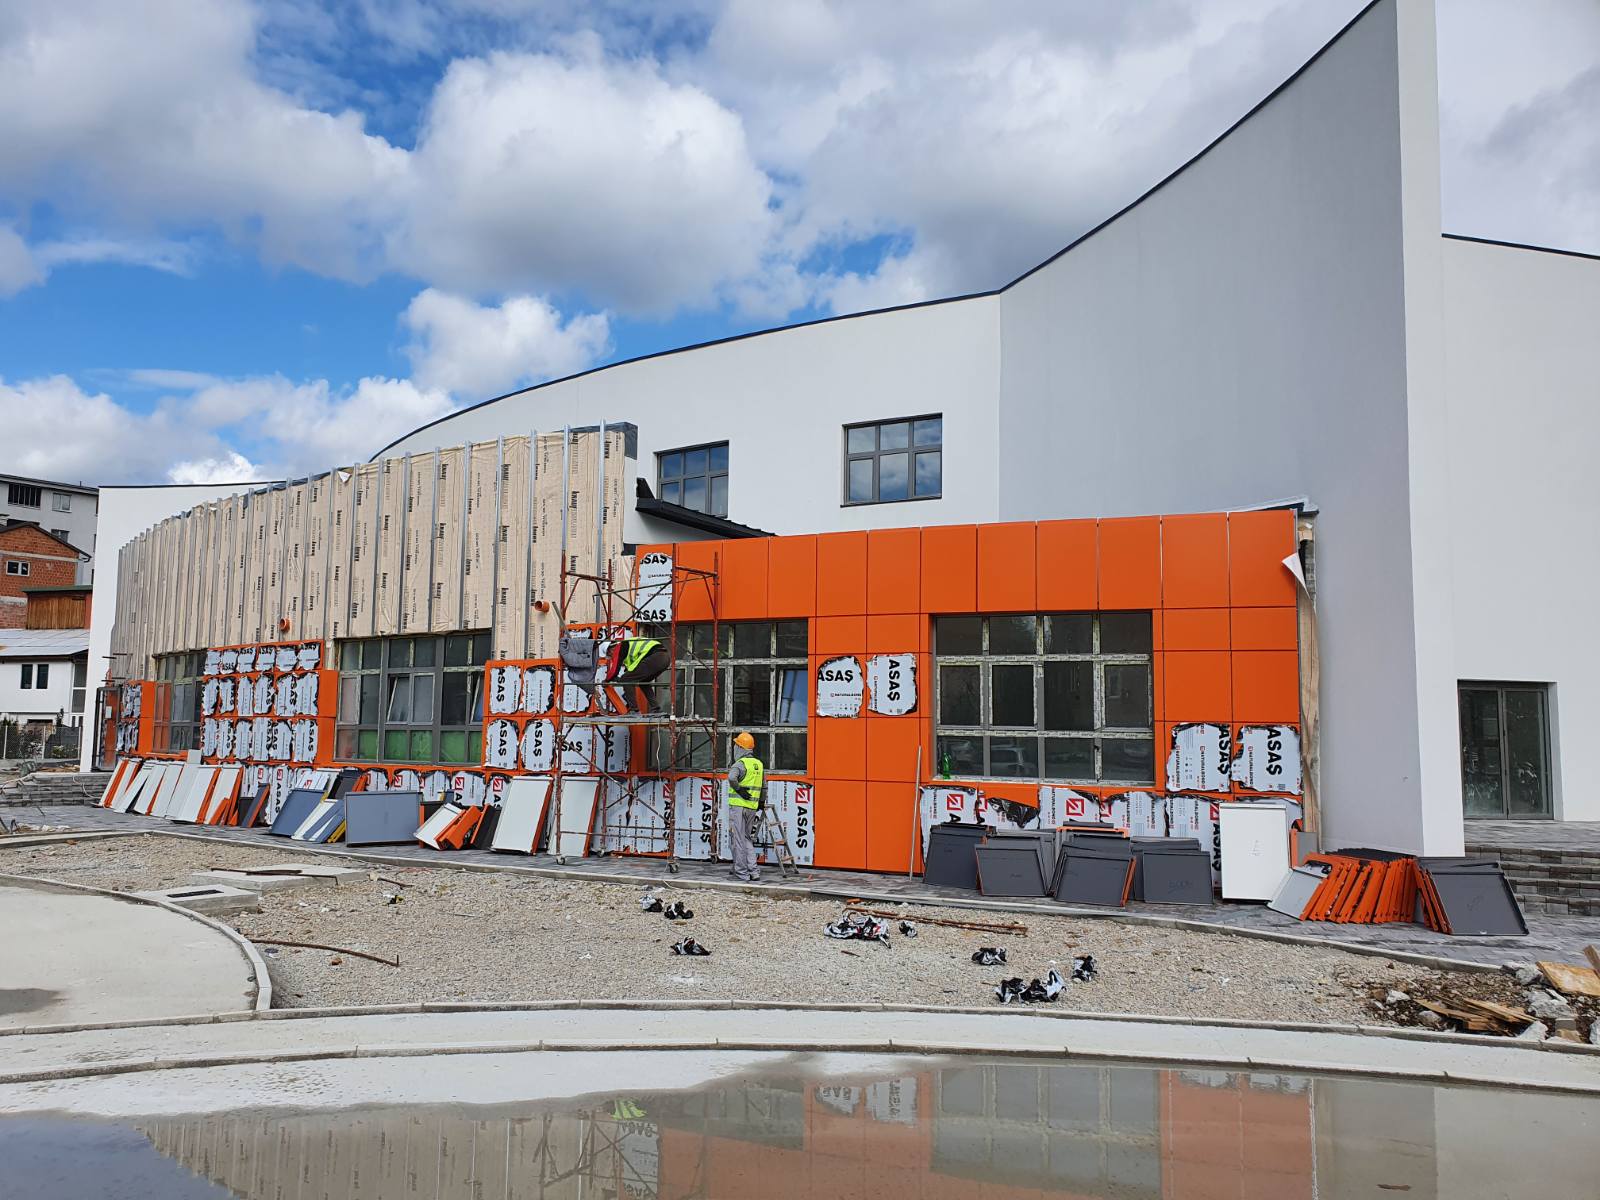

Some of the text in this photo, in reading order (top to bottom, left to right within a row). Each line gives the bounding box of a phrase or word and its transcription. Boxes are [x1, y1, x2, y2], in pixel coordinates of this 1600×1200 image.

[818, 670, 854, 683] ASAŞ
[887, 659, 900, 701] ASAŞ
[498, 720, 507, 757] ASAŞ
[532, 721, 542, 757] ASAŞ
[1266, 728, 1283, 776] ASAŞ
[796, 806, 808, 849] ASAŞ
